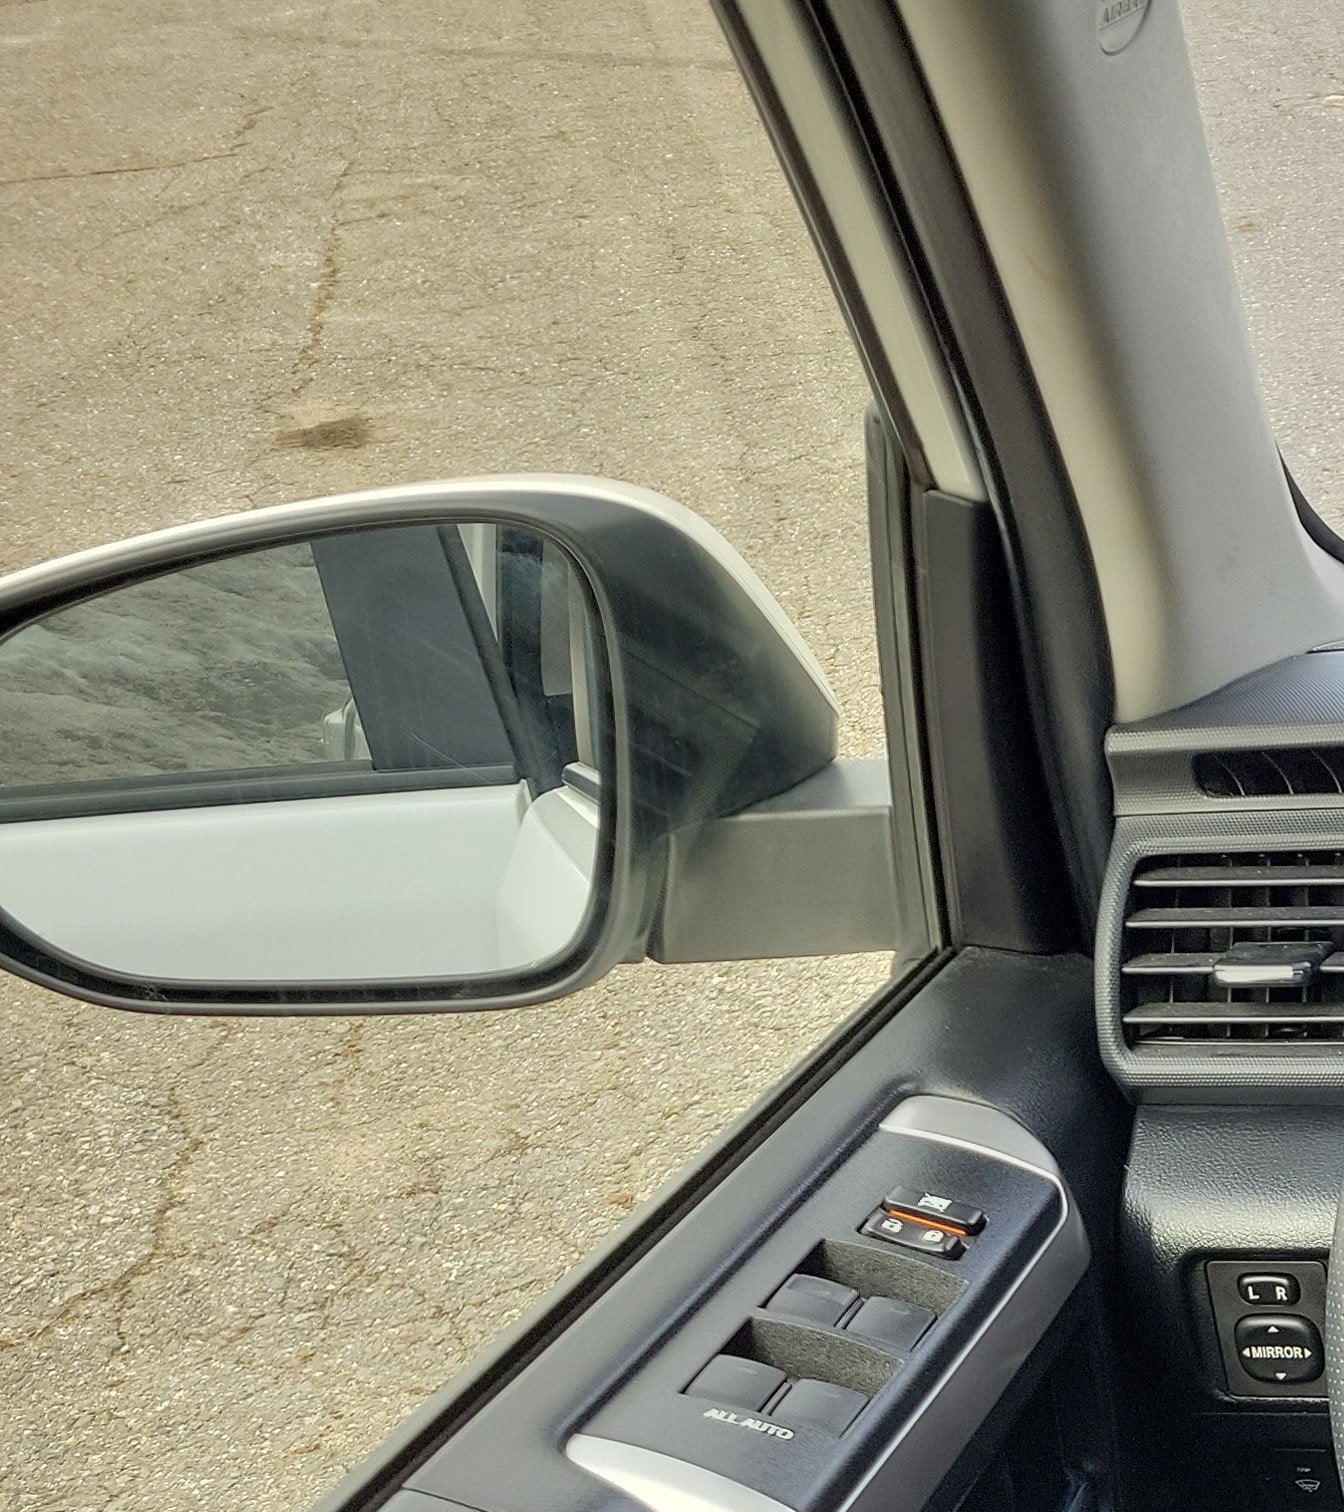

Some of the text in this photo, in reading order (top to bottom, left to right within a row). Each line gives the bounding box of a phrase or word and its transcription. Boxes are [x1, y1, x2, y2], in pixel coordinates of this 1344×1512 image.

[1247, 1286, 1288, 1300] L R
[1251, 1346, 1303, 1359] MIRROR
[703, 1407, 795, 1441] ALL AUTO
